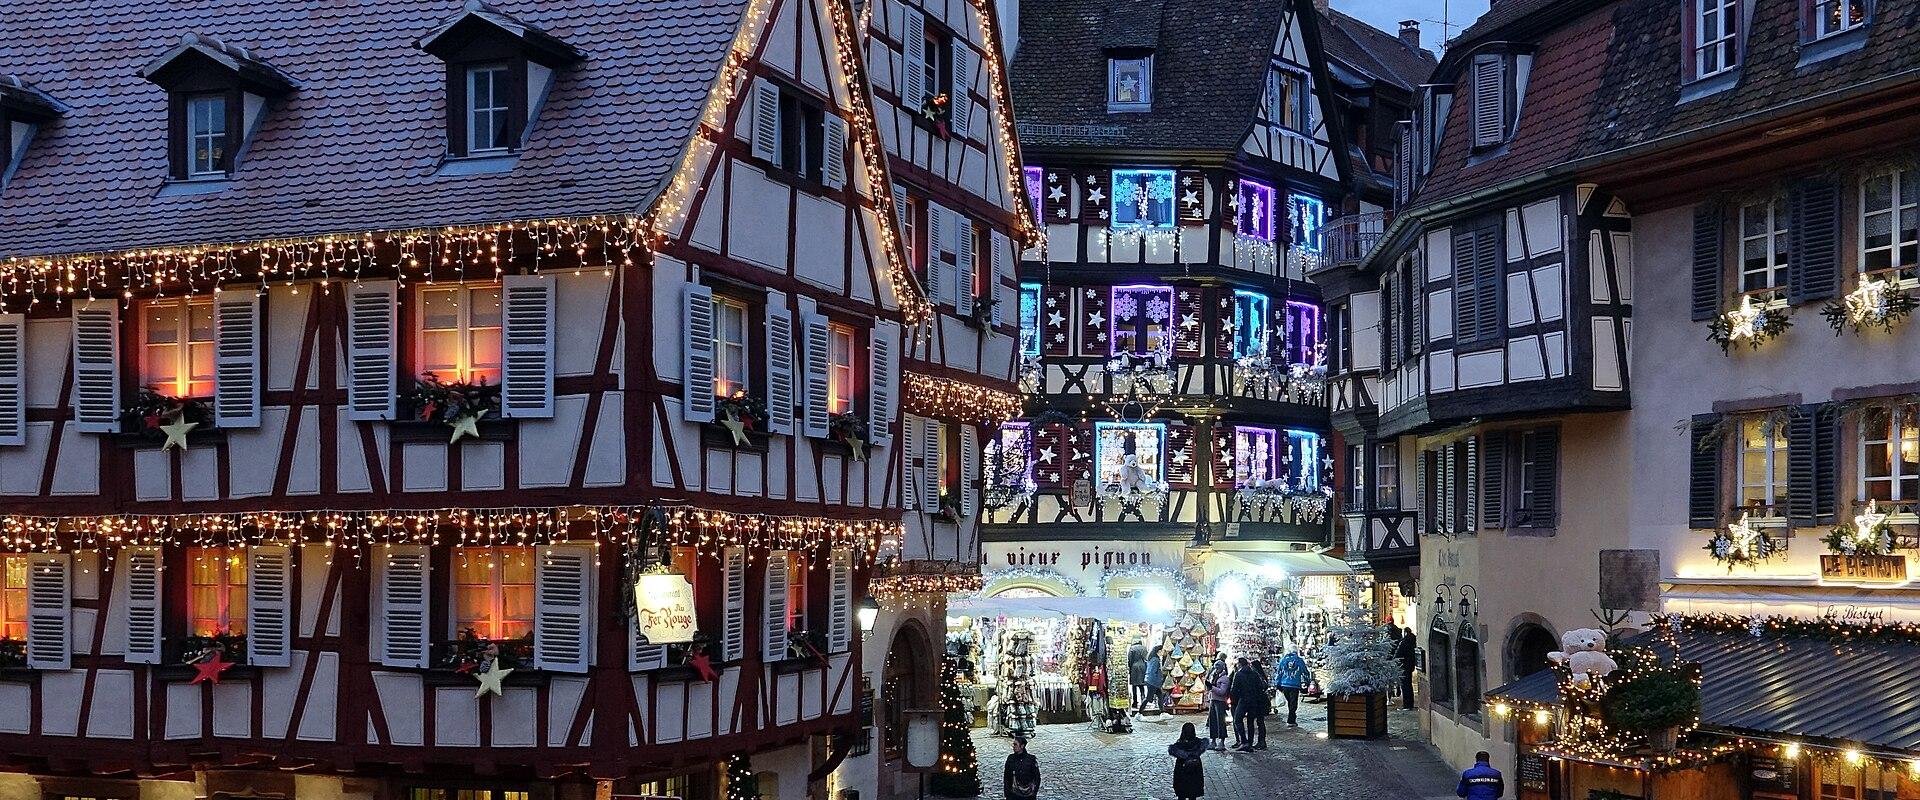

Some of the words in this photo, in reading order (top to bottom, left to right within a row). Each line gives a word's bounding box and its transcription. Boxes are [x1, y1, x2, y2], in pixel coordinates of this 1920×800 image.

[1006, 546, 1061, 566] vieux
[1080, 545, 1151, 571] pignon
[640, 608, 662, 630] Fer
[660, 607, 693, 630] Rouge
[1824, 604, 1838, 620] Le
